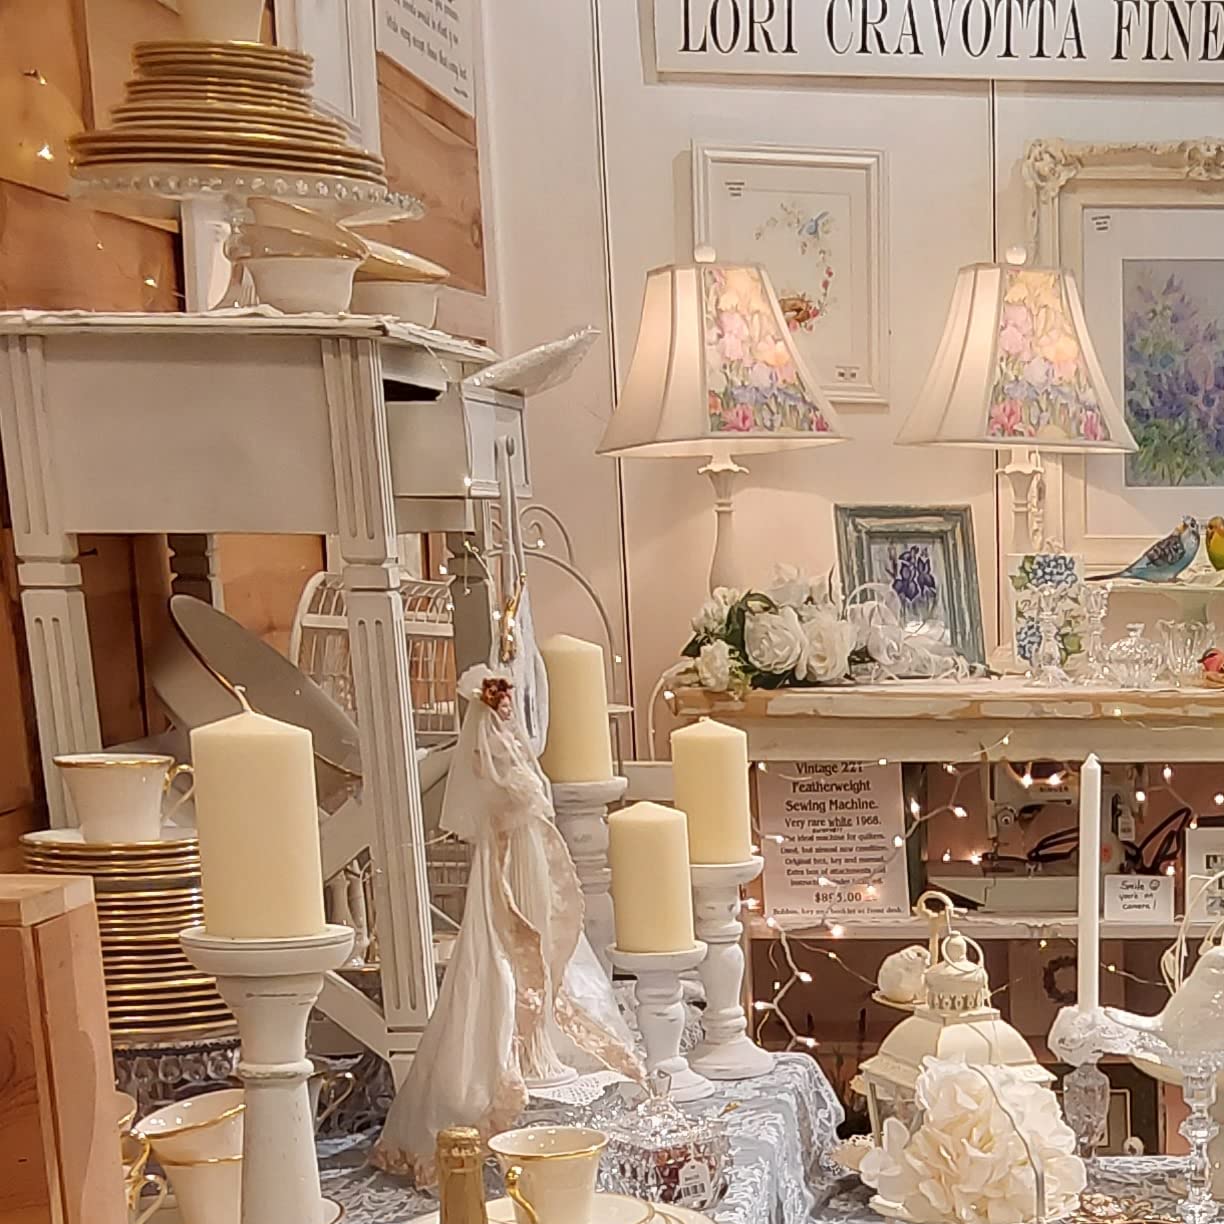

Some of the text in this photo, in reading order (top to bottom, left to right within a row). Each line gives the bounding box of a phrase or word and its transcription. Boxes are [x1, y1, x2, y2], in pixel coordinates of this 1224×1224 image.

[678, 0, 798, 53] LORI
[826, 0, 1087, 59] CRAVOTTA
[796, 762, 838, 775] Vintage
[791, 780, 871, 793] Featherweight
[785, 800, 826, 813] Sewing
[785, 818, 805, 829] Very
[808, 818, 826, 827] rare
[828, 816, 852, 827] white
[847, 833, 857, 841] for
[1120, 880, 1145, 890] Smile
